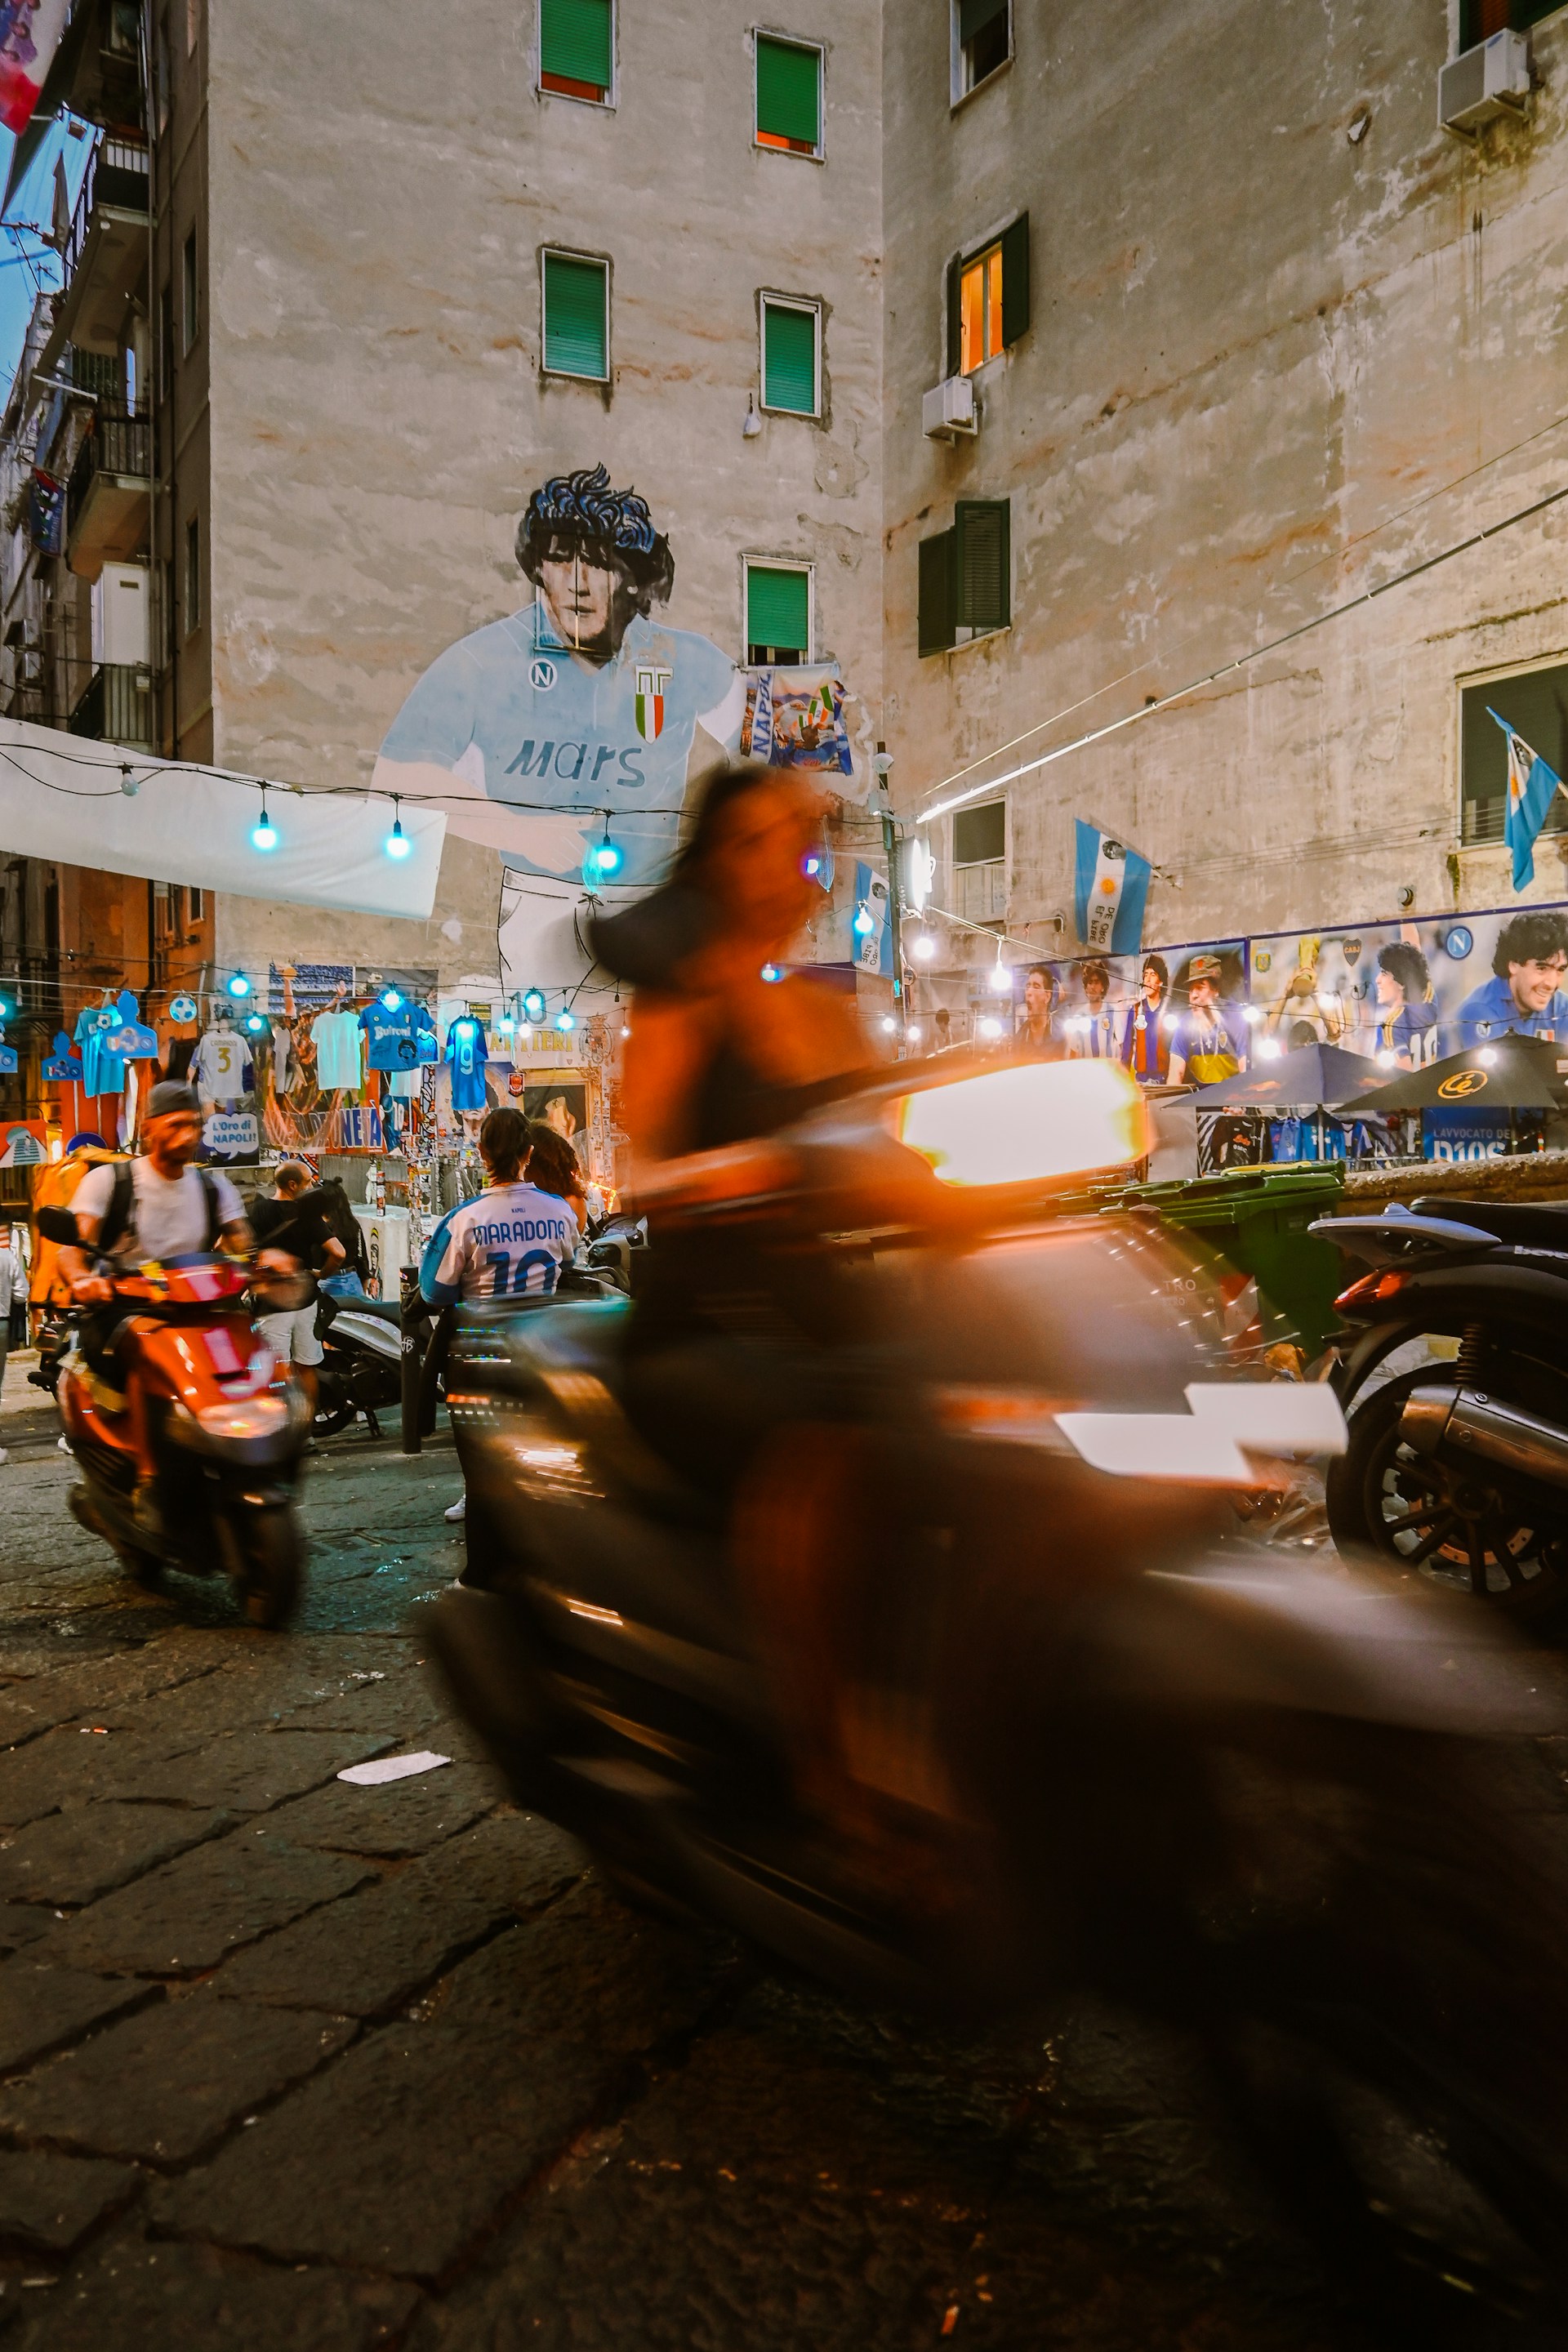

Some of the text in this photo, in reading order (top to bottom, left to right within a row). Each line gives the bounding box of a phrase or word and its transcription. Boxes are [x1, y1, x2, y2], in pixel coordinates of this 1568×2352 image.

[504, 739, 646, 787] Mars
[485, 1031, 573, 1052] ARTIERI
[217, 1047, 231, 1073] 3
[460, 1042, 474, 1076] 9
[212, 1120, 252, 1131] L'Oro di
[213, 1133, 256, 1143] NAPOLI!
[1496, 1129, 1512, 1139] DE
[473, 1219, 565, 1246] MARADONA
[487, 1249, 557, 1295] 10
